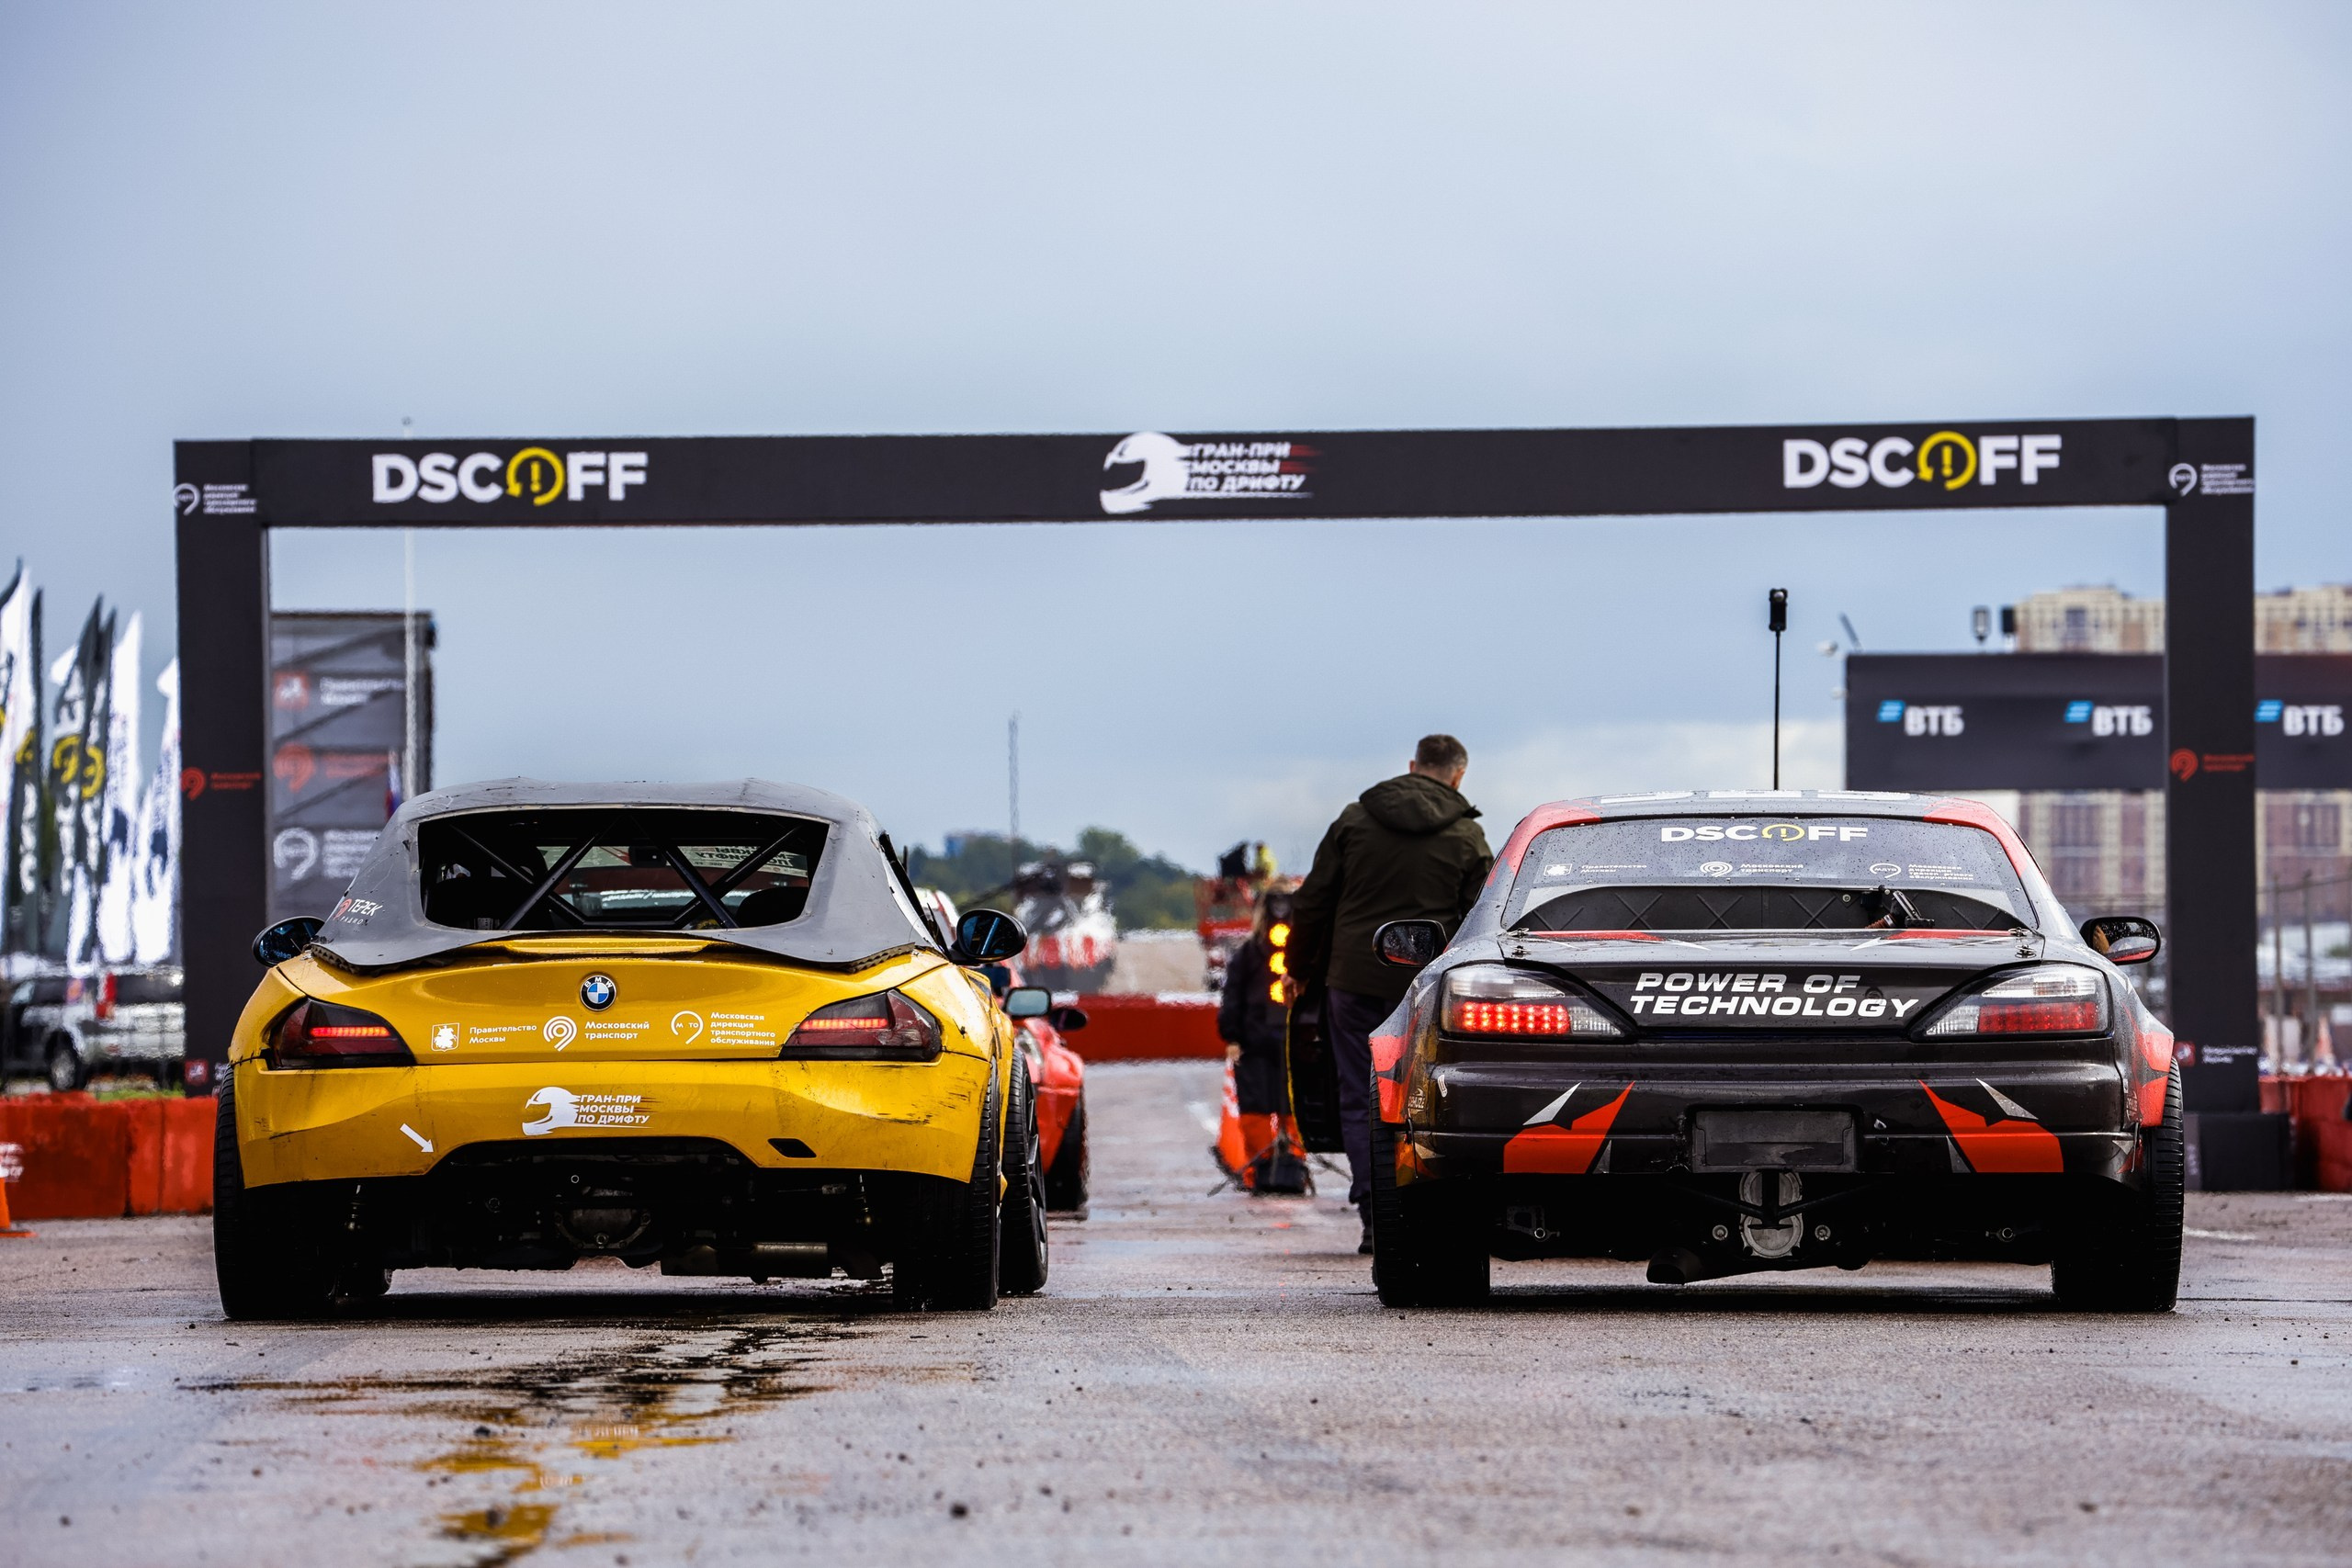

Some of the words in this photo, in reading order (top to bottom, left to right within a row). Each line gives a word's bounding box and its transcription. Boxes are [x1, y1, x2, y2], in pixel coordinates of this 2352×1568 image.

[1193, 442, 1291, 458] ГРАН-ПРИ
[1192, 458, 1281, 475] МОСКВЫ
[1189, 475, 1219, 491] ПО
[1220, 474, 1306, 492] ДРИФТУ
[1905, 705, 1964, 736] ВТБ
[2093, 705, 2153, 736] ВТБ
[2283, 705, 2345, 736] ВТБ
[583, 976, 614, 988] BMW
[1635, 973, 1787, 993] POWER
[1803, 975, 1860, 994] OF
[1630, 995, 1919, 1018] TECHNOLOGY
[710, 1011, 764, 1021] Московская
[469, 1024, 537, 1034] Правительство
[710, 1029, 775, 1038] транспортного
[469, 1036, 506, 1044] Москвы
[584, 1032, 639, 1041] транспорт
[710, 1037, 775, 1046] обслуживания
[581, 1094, 642, 1103] ГРАН-ПРИ
[579, 1104, 635, 1113] МОСКВЫ
[577, 1114, 595, 1123] ПО
[597, 1115, 650, 1125] ДРИФТУ
